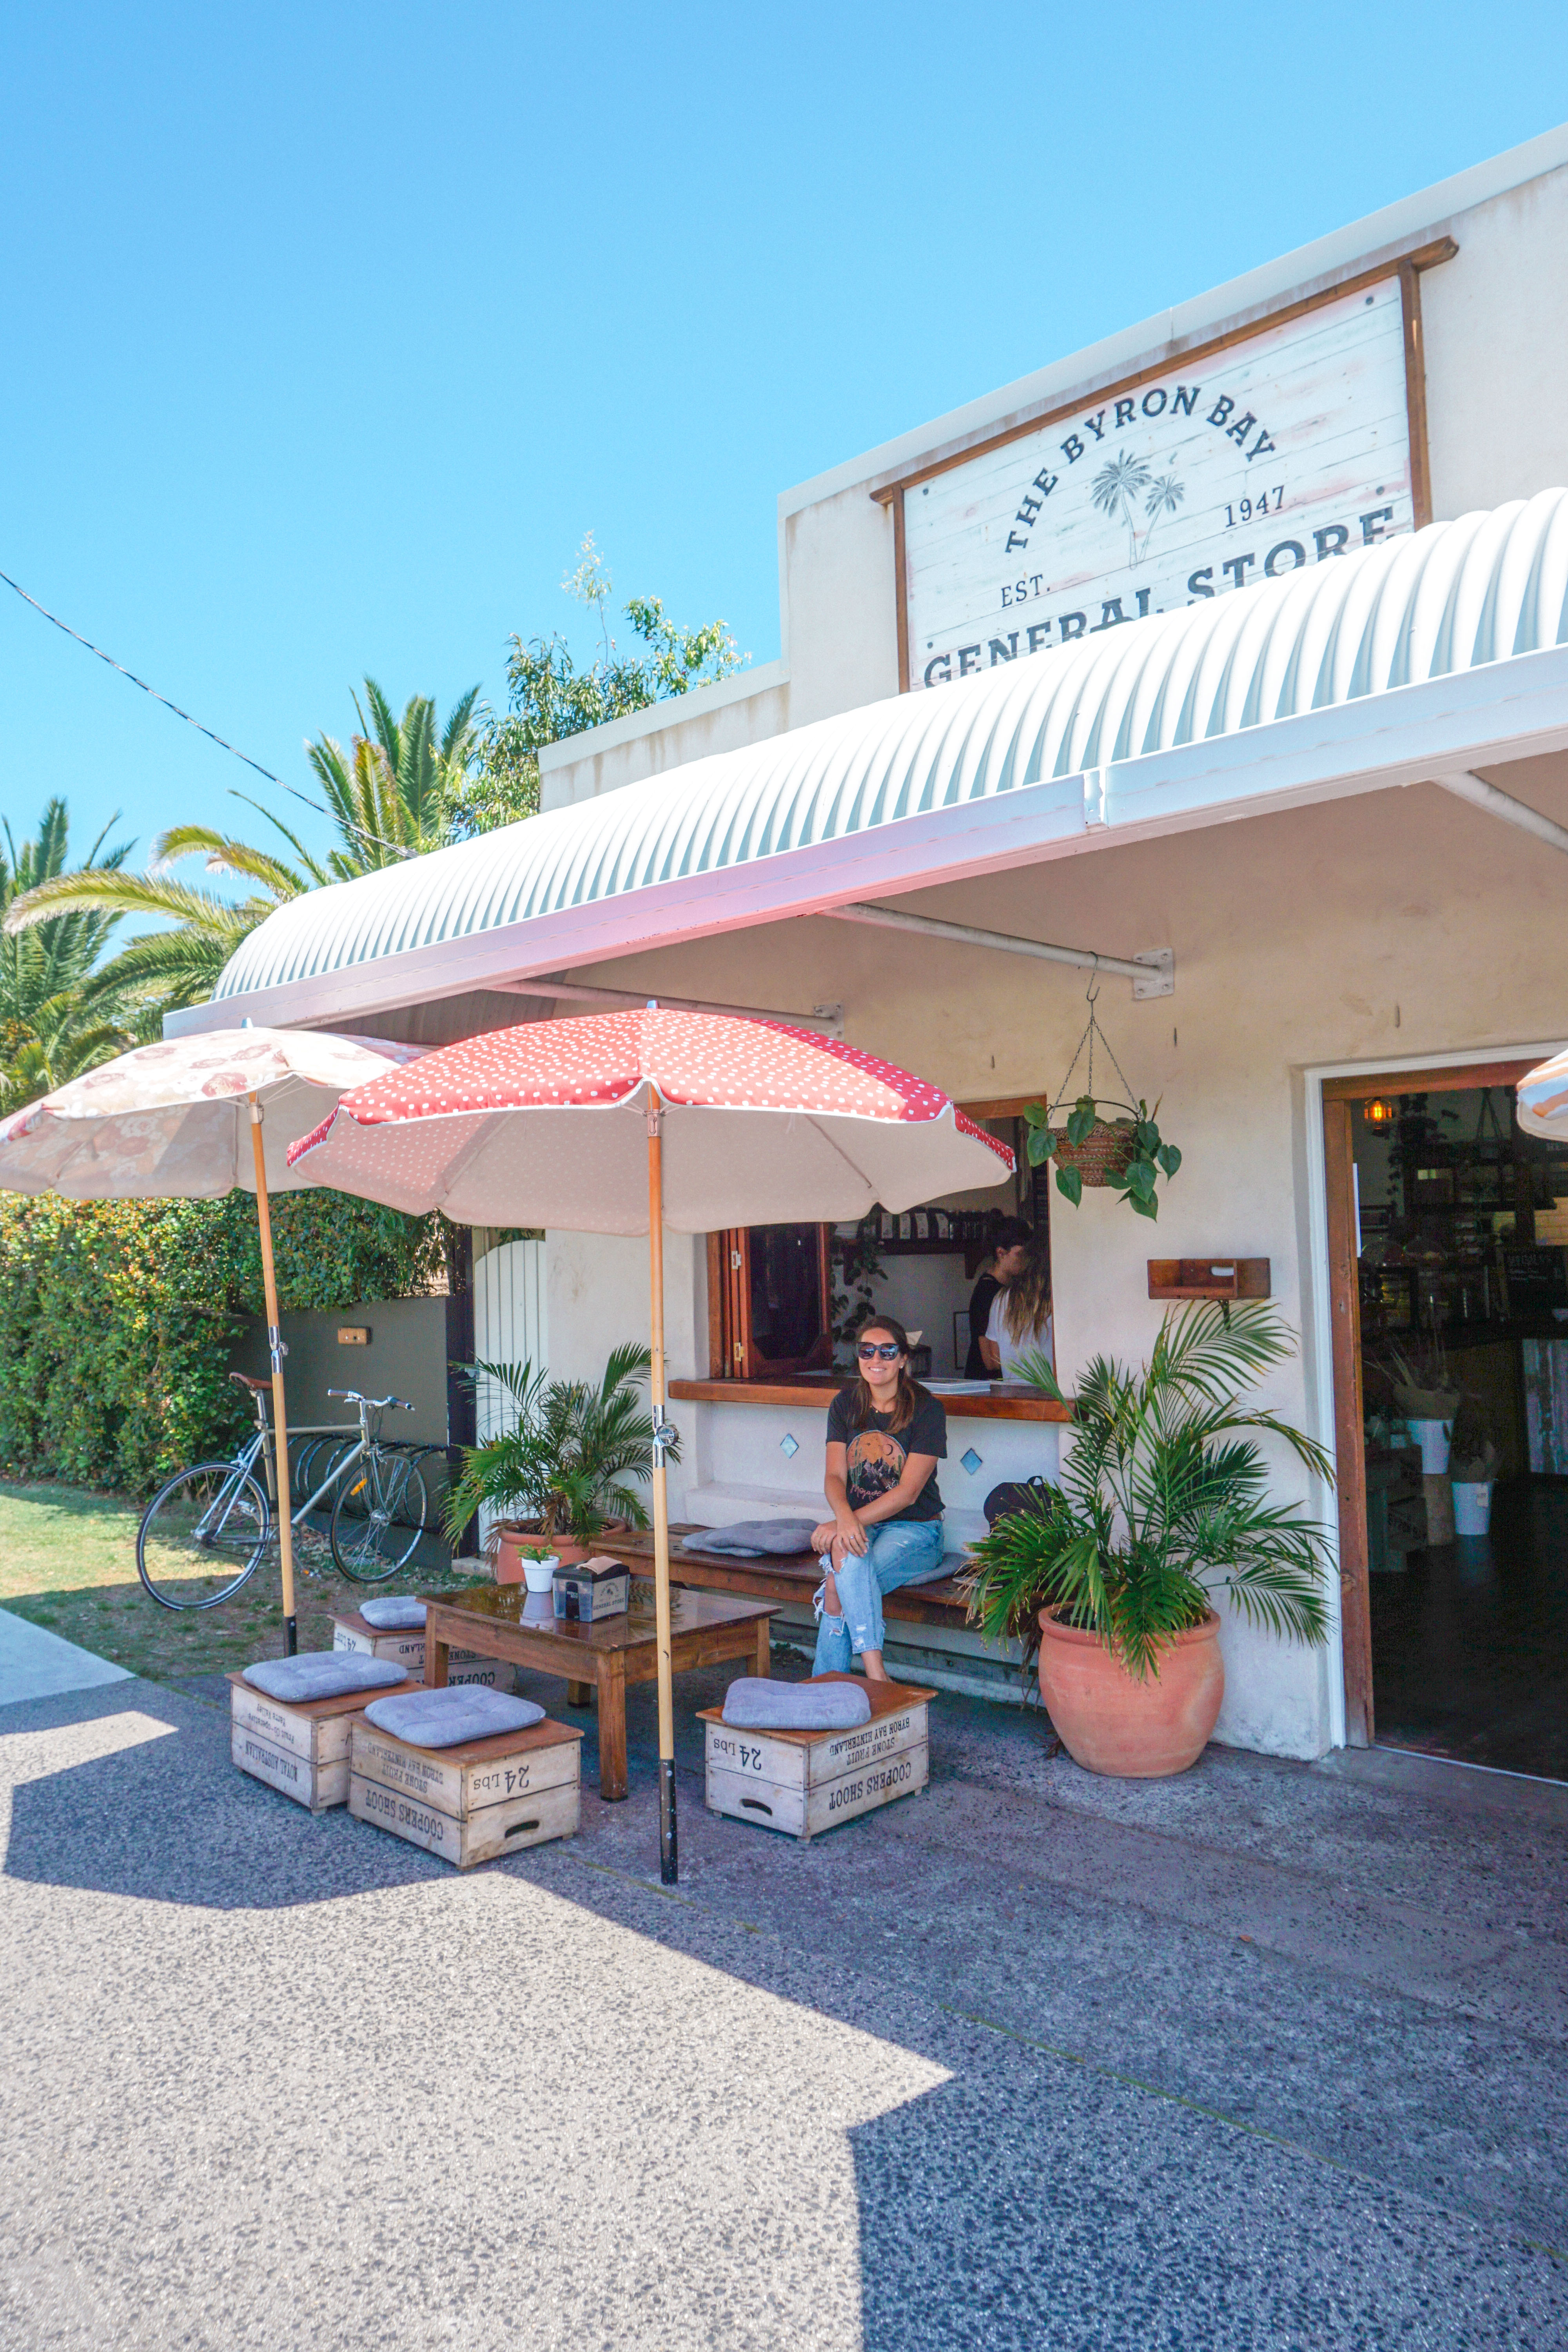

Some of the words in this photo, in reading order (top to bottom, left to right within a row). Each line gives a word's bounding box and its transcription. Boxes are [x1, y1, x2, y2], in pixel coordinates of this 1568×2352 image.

[1005, 467, 1059, 553] THE
[1060, 385, 1201, 464] BYRON
[1207, 394, 1276, 462] BAY
[1001, 574, 1051, 607] EST.
[1225, 485, 1285, 528] 1947
[1187, 506, 1394, 606] STORE
[448, 1671, 495, 1687] COOPER
[257, 1703, 271, 1719] Valley
[281, 1730, 294, 1744] Fruit
[875, 1726, 887, 1740] BAY
[889, 1717, 910, 1734] BYRON
[245, 1740, 279, 1770] AUSTRALIAN
[368, 1742, 406, 1768] HINTERLAND
[714, 1739, 735, 1756] Lbs
[829, 1731, 872, 1756] HINTERLAND
[872, 1737, 895, 1756] STONE
[408, 1759, 420, 1774] BAY
[739, 1745, 761, 1770] 24
[847, 1747, 869, 1766] FRUIT
[280, 1758, 298, 1782] ROYAL
[382, 1764, 403, 1783] FRUIT
[422, 1763, 444, 1785] BYRON
[504, 1765, 529, 1793] 24
[867, 1762, 911, 1795] COOPERS
[405, 1773, 428, 1794] STONE
[474, 1774, 500, 1790] Lbs
[365, 1789, 396, 1818] SHOOT
[829, 1781, 863, 1810] SHOOT
[399, 1804, 443, 1840] COOPERS
